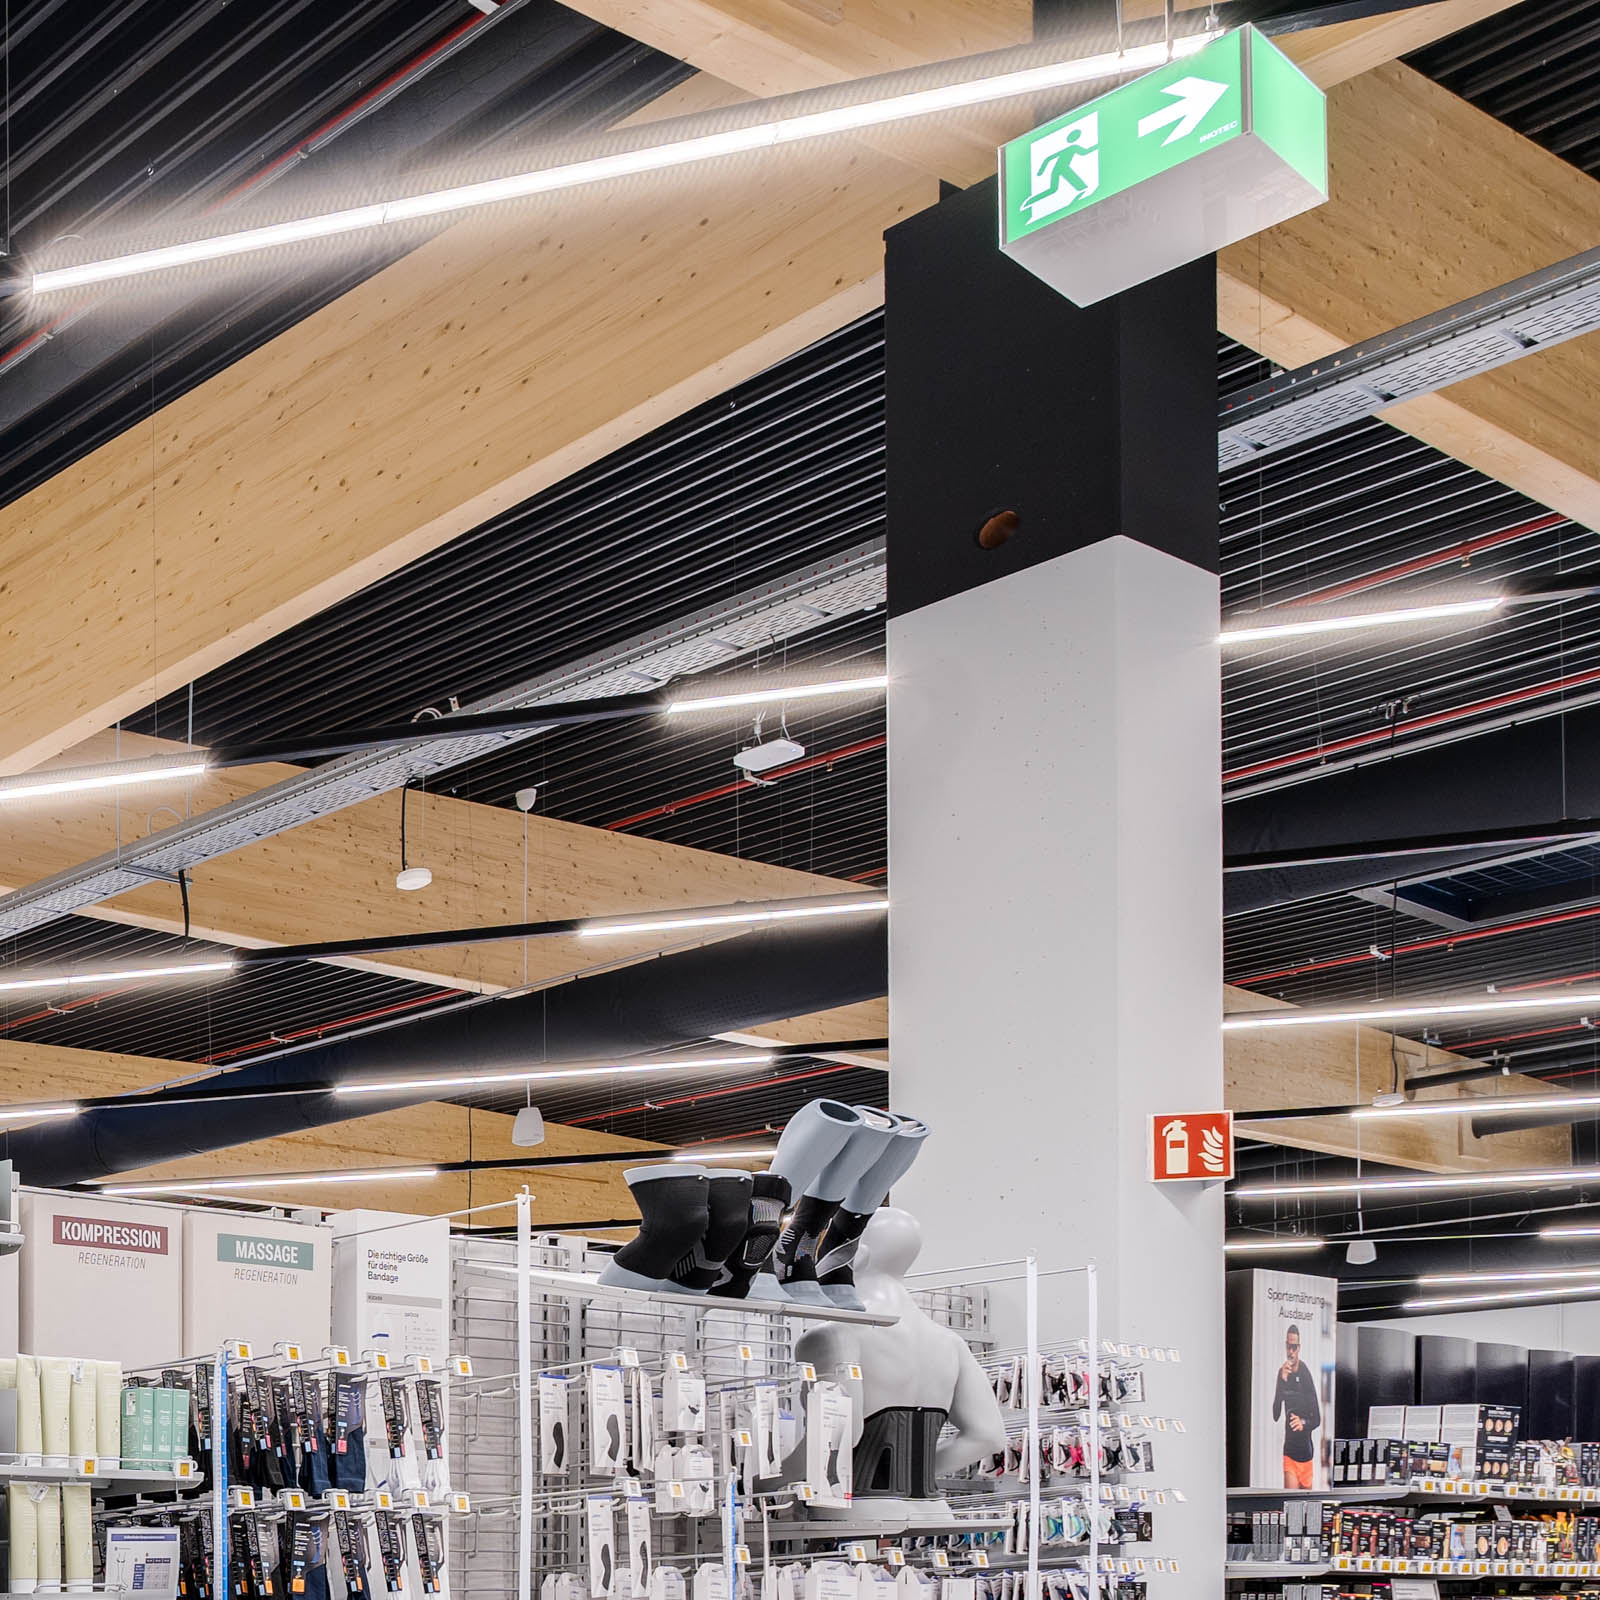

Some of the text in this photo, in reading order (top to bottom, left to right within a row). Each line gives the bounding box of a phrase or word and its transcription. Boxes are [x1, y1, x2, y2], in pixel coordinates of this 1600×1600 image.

[1200, 120, 1237, 143] INOTEC
[61, 1220, 161, 1250] KOMPRESSION
[78, 1251, 146, 1270] REGENERATION
[235, 1240, 298, 1264] MASSAGE
[368, 1250, 428, 1263] Die richtige Größe
[368, 1261, 397, 1271] für deine
[234, 1268, 297, 1285] REGENERATION
[368, 1271, 399, 1283] Bandage
